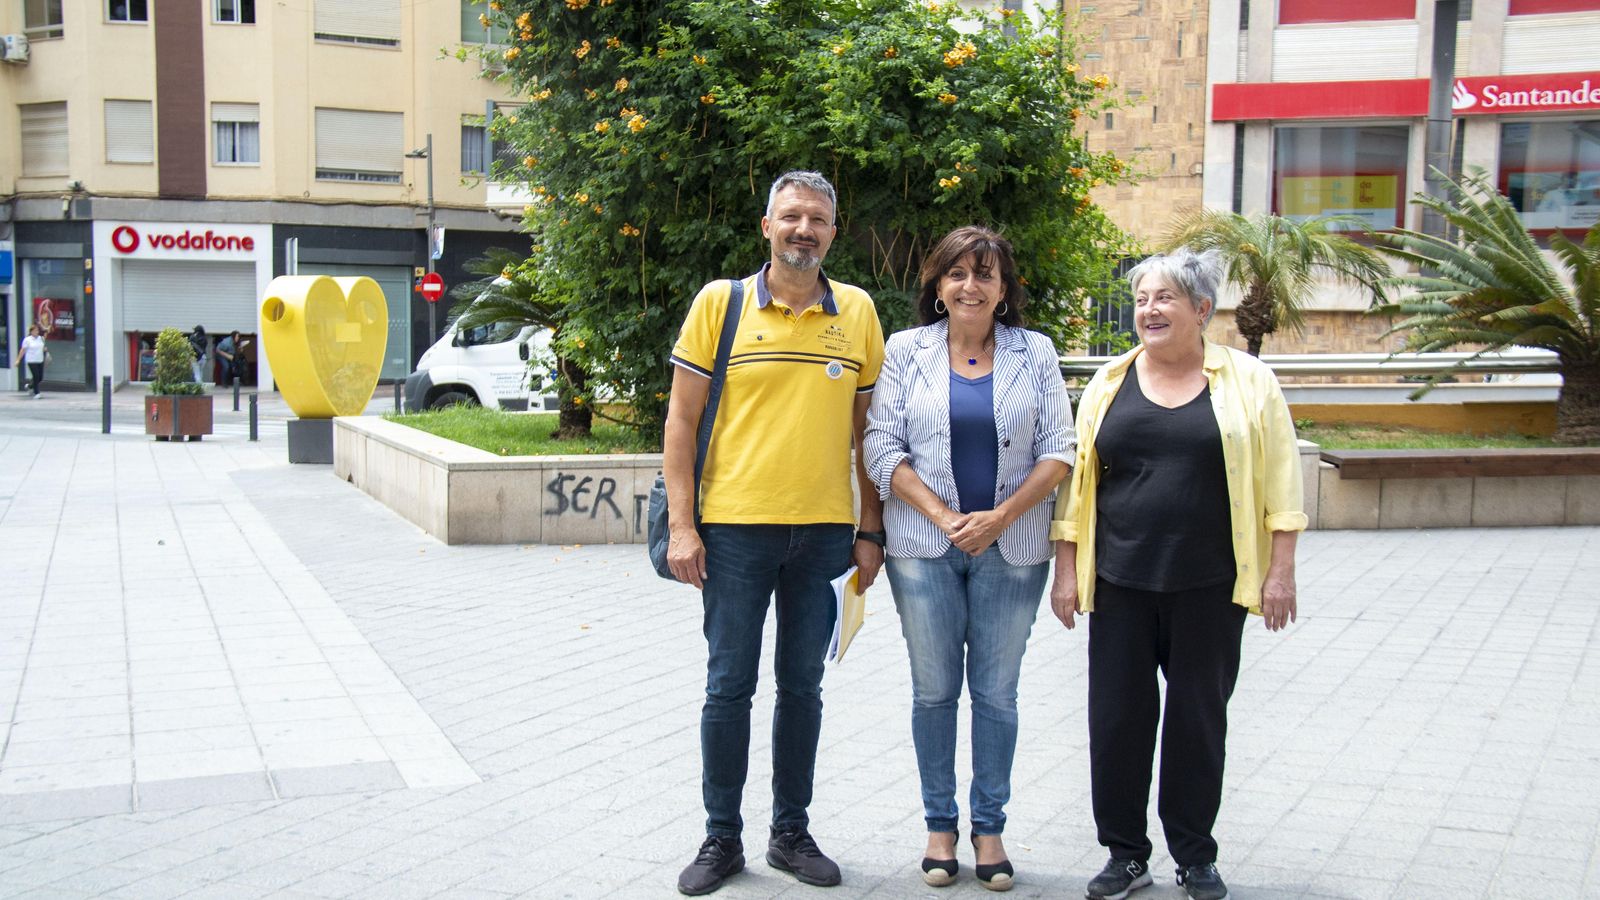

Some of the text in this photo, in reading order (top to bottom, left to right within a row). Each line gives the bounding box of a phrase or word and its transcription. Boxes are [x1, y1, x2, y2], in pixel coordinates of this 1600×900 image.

[1481, 79, 1600, 108] Santande
[147, 230, 254, 252] vodafone
[634, 493, 648, 534] T
